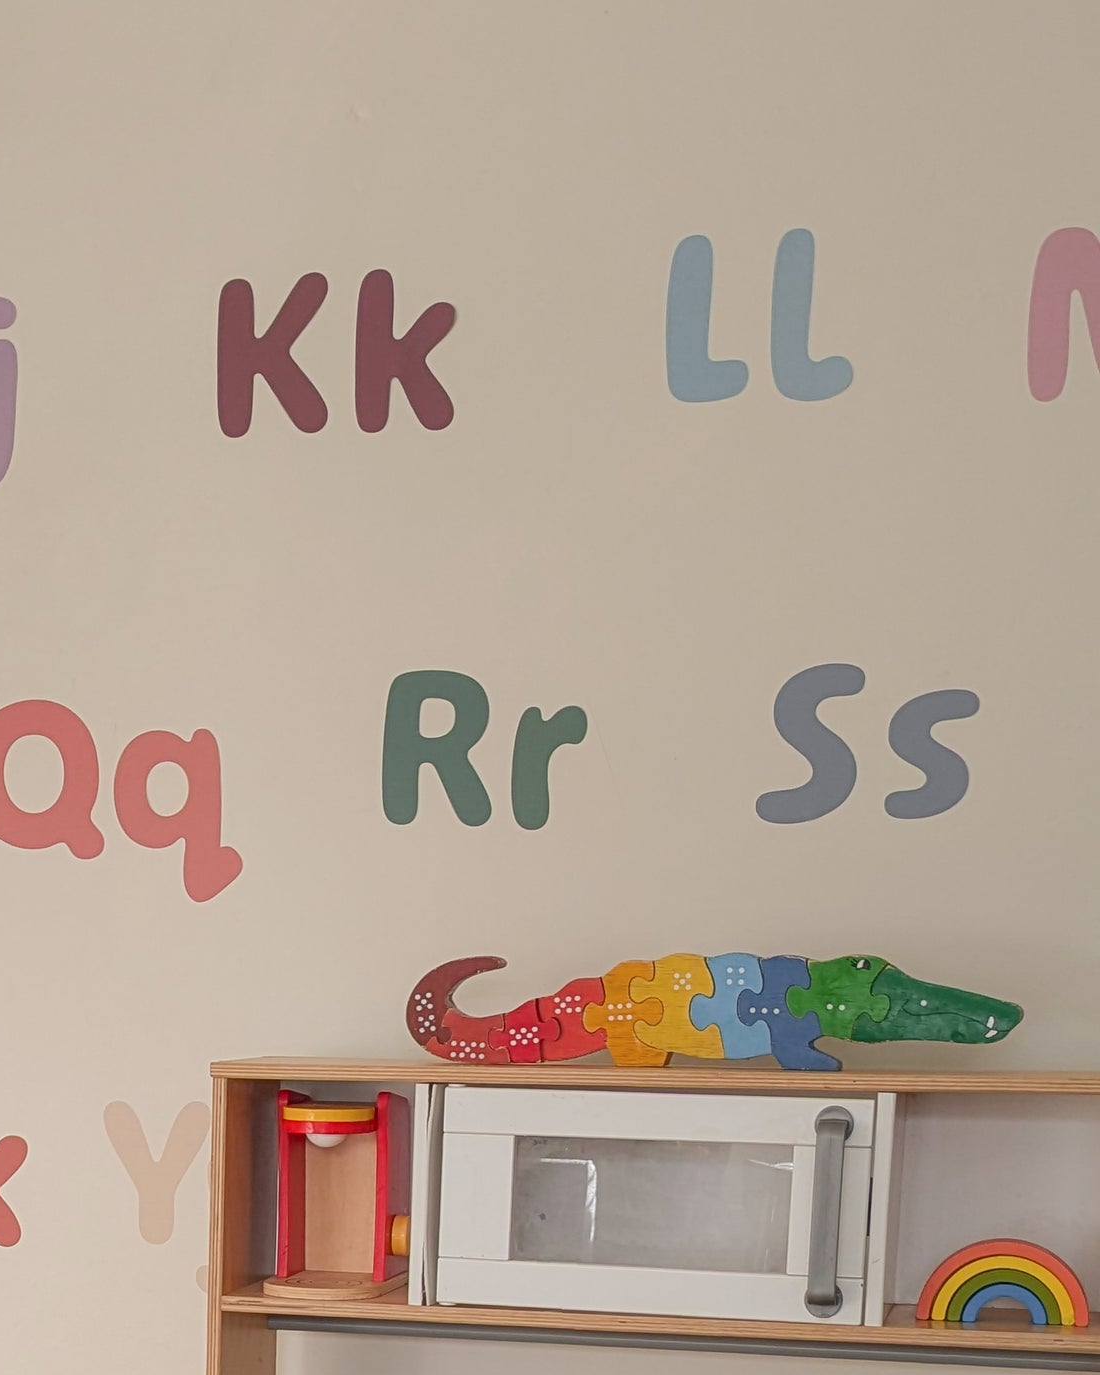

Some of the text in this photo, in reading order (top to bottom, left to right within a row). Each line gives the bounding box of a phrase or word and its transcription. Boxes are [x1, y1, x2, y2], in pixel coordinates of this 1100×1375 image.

[216, 269, 458, 438] Kk
[666, 228, 853, 403] Ll
[381, 669, 588, 831] Rr
[755, 662, 980, 825] Ss
[103, 1101, 211, 1293] Y
